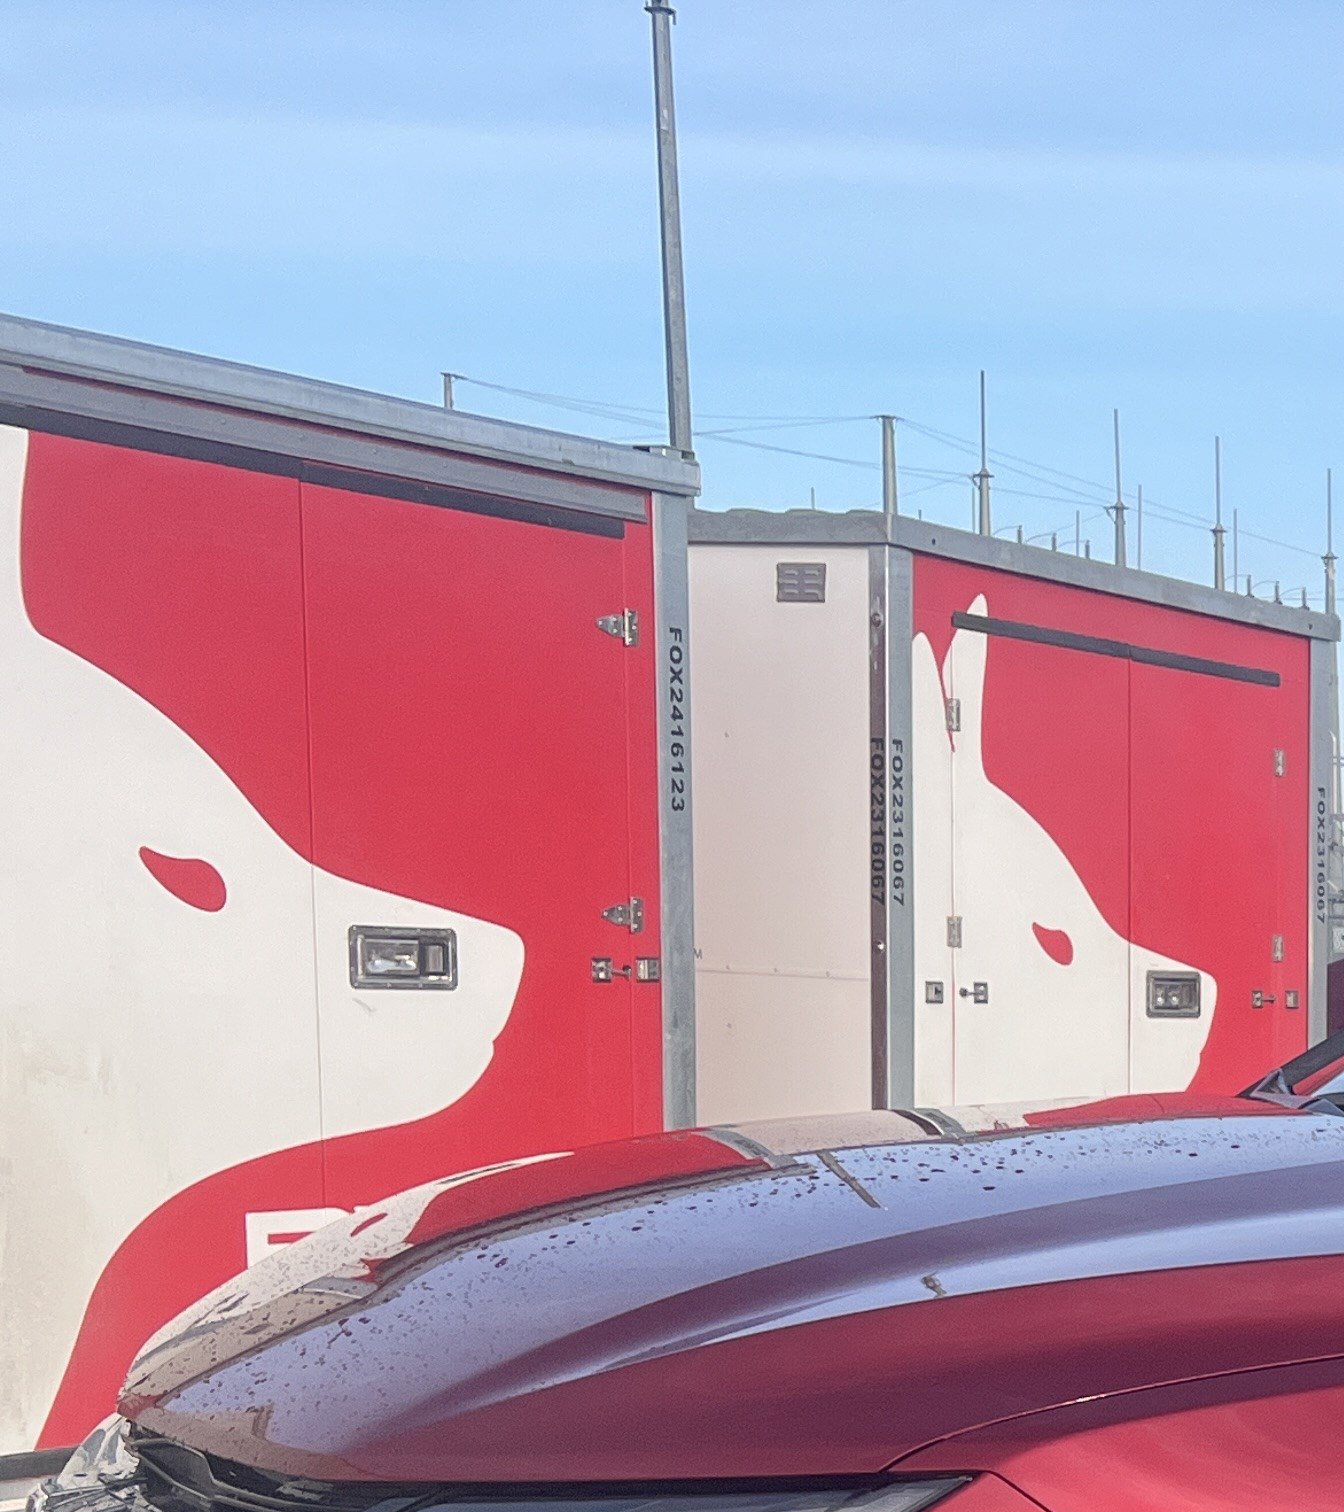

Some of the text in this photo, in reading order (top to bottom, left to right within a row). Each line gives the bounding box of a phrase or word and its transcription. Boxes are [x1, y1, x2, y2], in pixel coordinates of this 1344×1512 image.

[669, 627, 685, 812] FOX2416123
[870, 737, 886, 906] FOX2316067
[892, 738, 905, 906] FOX2316067
